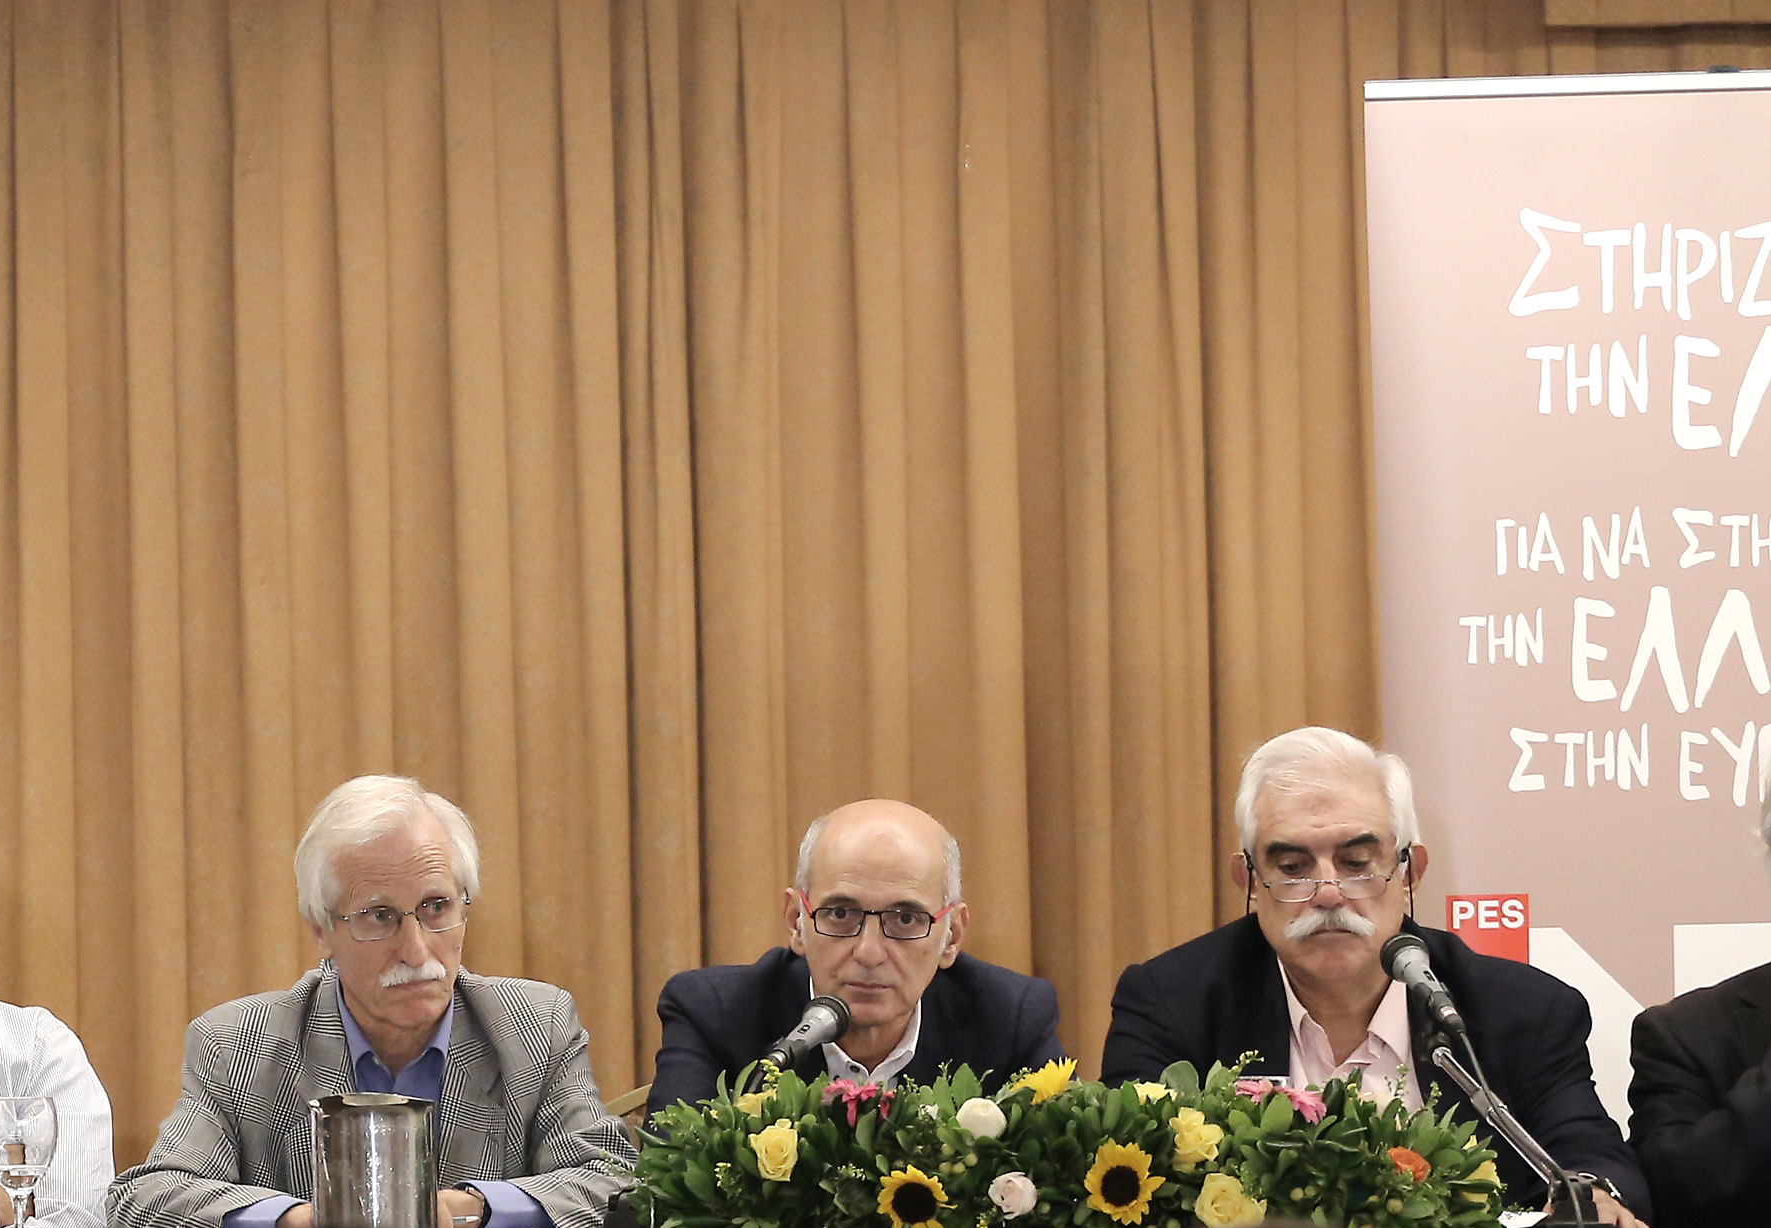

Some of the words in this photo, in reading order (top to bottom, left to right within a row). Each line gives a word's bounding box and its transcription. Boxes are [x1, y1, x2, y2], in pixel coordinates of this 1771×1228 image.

[1525, 332, 1649, 418] ΤΗΝ
[1495, 511, 1566, 577] ΓΙΑ
[1581, 505, 1651, 582] ΝΑ
[1458, 607, 1544, 667] ΤΗΝ
[1508, 722, 1650, 792] ΣΤΗΝ
[1451, 899, 1525, 930] PES
